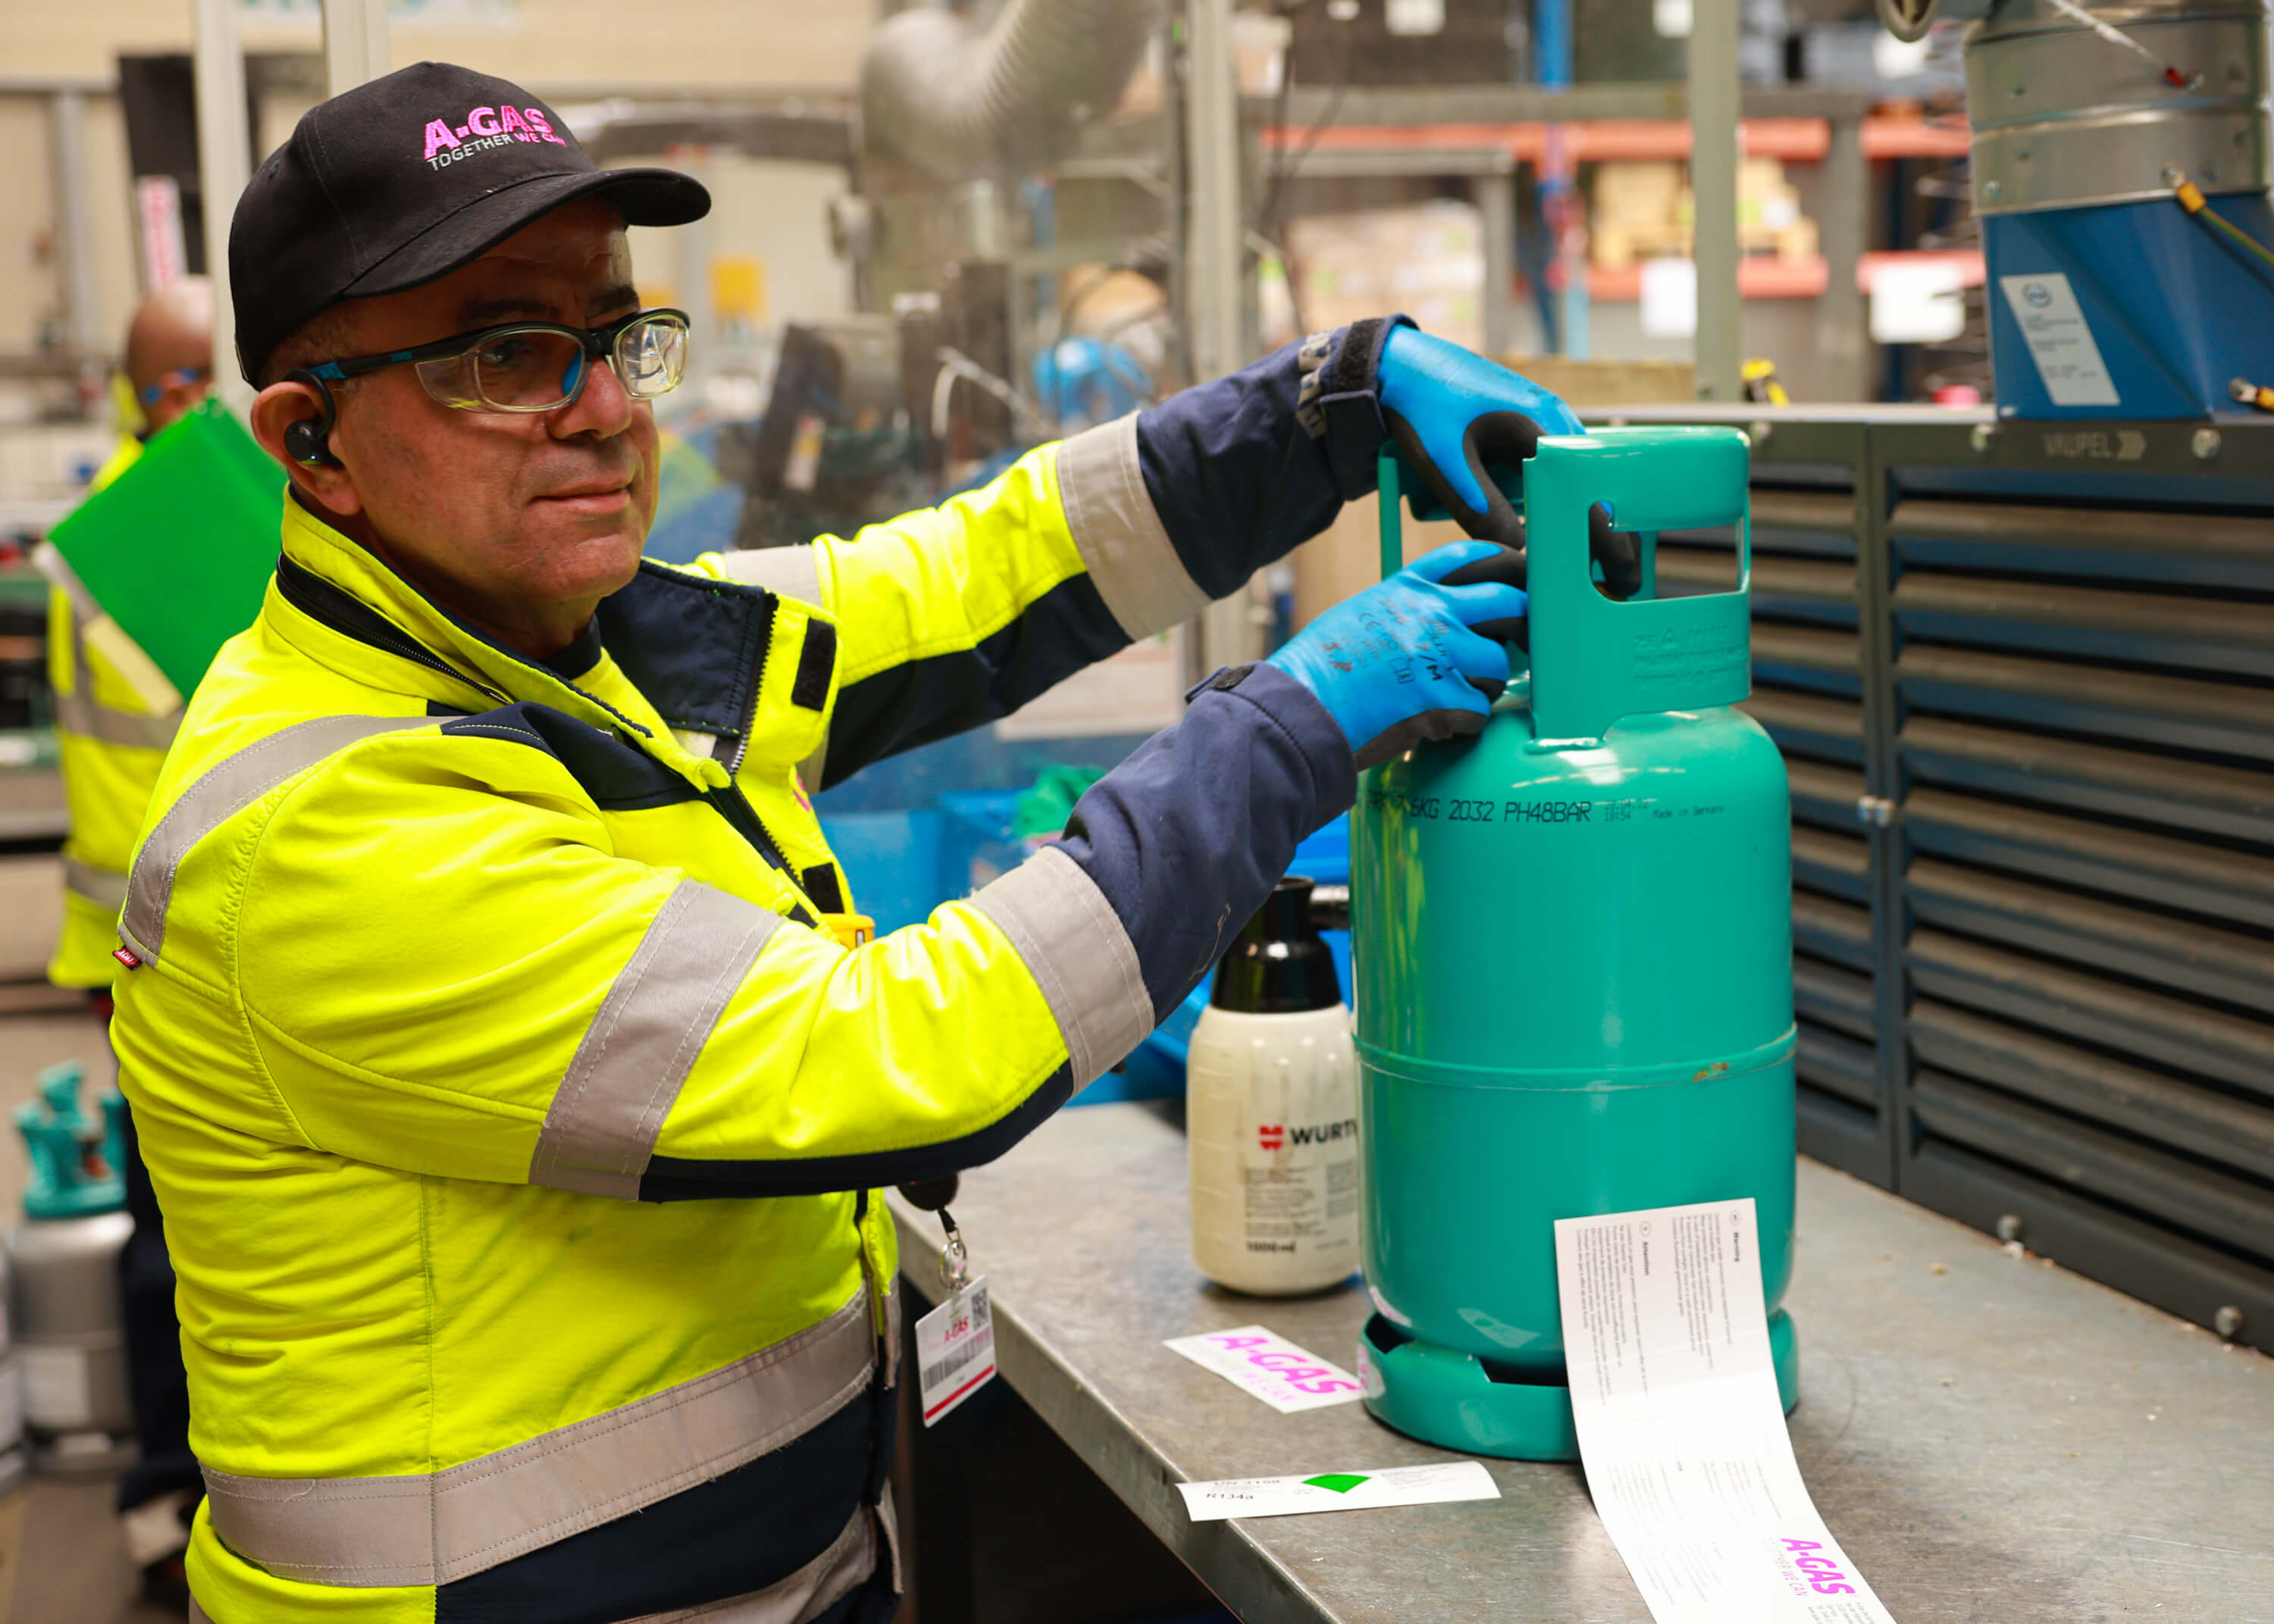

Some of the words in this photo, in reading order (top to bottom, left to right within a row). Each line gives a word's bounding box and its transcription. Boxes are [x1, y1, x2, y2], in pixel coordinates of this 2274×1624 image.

[424, 105, 554, 160] A-GAS
[427, 133, 515, 172] TOGETHER
[514, 132, 541, 144] WE
[1448, 799, 1495, 822] 2032
[1504, 801, 1592, 824] PH48BAR
[1289, 1119, 1358, 1145] WURT
[1207, 1336, 1361, 1394] A-GAS
[1780, 1538, 1856, 1594] A-GAS
